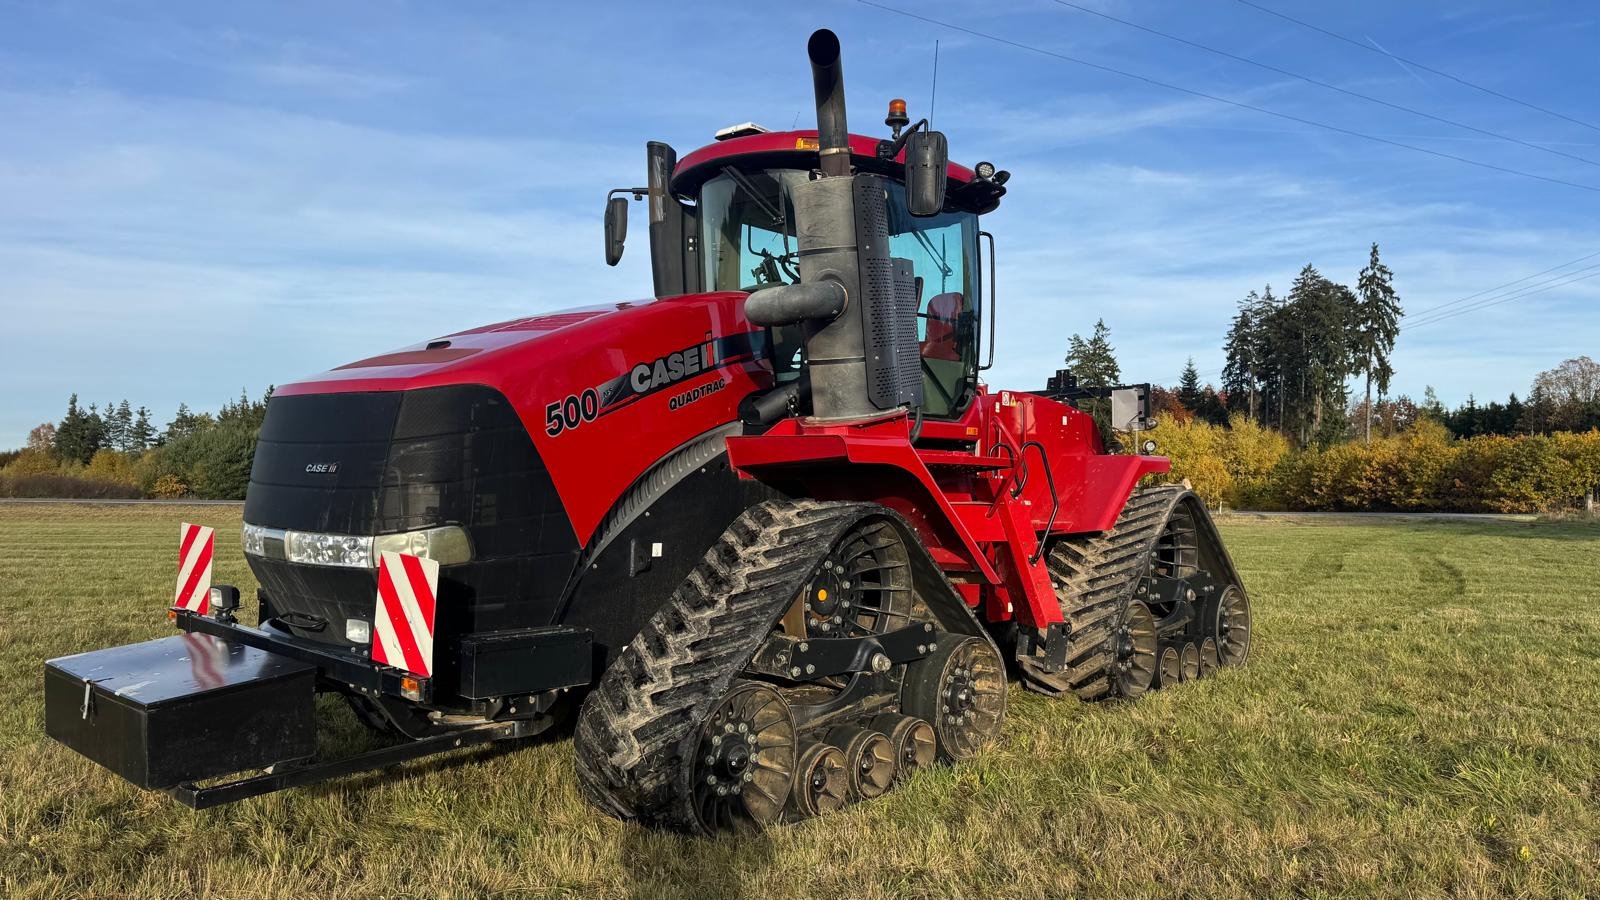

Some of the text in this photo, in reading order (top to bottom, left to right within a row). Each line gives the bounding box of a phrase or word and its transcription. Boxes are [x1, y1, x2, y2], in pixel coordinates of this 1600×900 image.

[630, 346, 700, 393] CASE
[545, 388, 599, 437] 500
[668, 378, 726, 411] QUADTRAC
[305, 463, 328, 473] CASE
